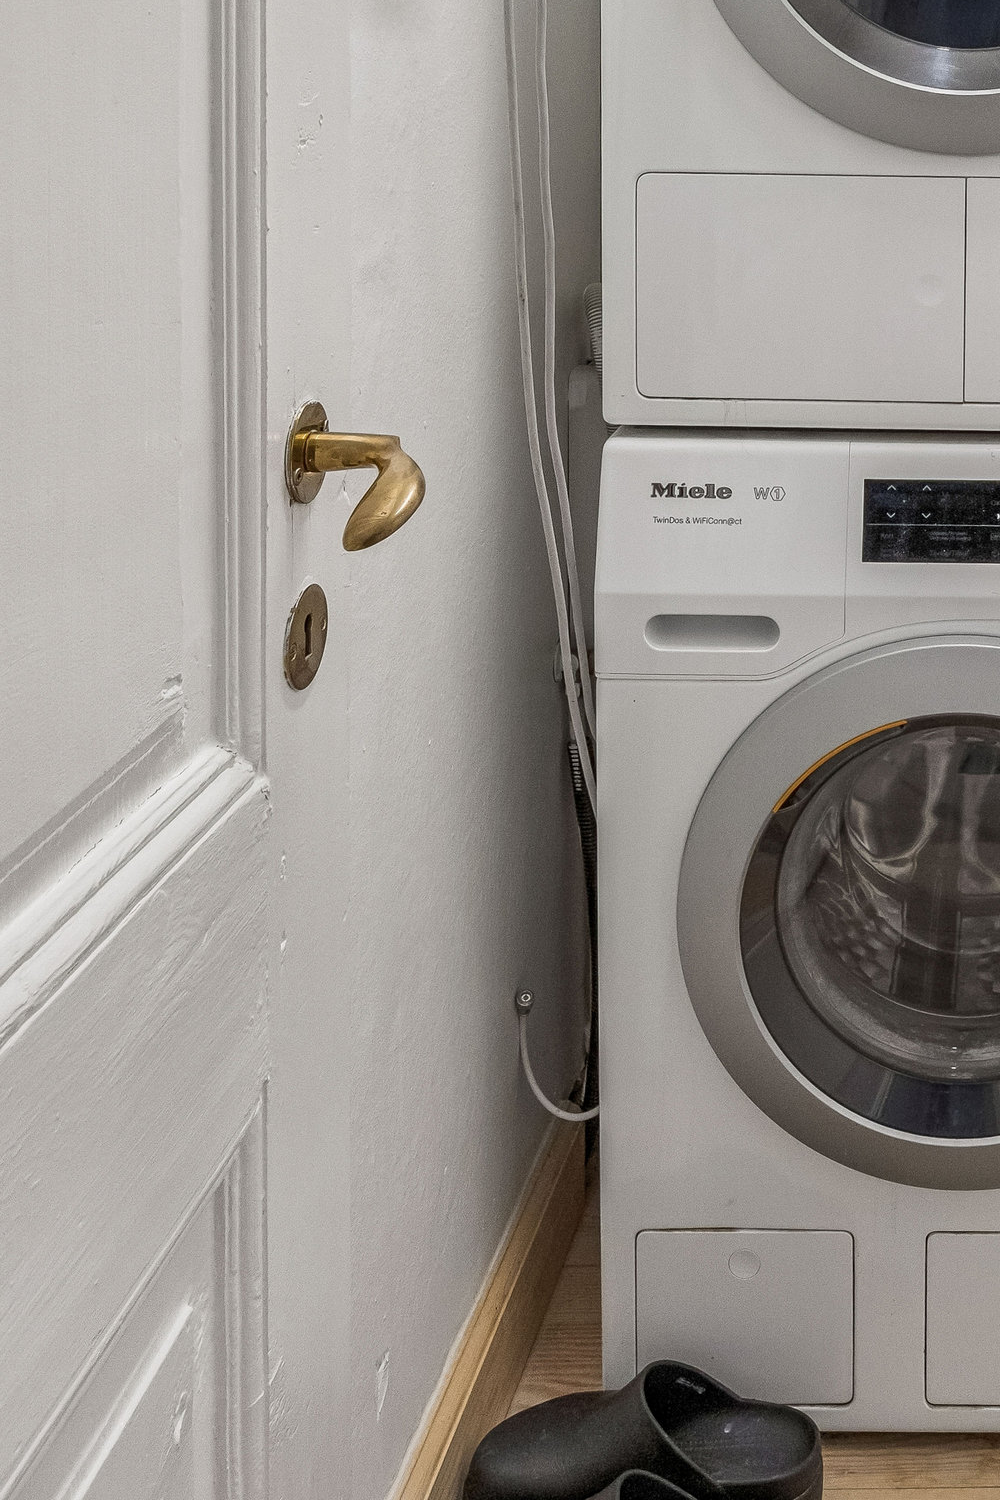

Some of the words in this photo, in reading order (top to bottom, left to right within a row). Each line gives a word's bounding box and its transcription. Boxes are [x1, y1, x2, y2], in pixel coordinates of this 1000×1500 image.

[650, 482, 733, 499] Miele
[653, 516, 684, 524] TwinDos
[692, 517, 742, 526] WiFiConn@ct
